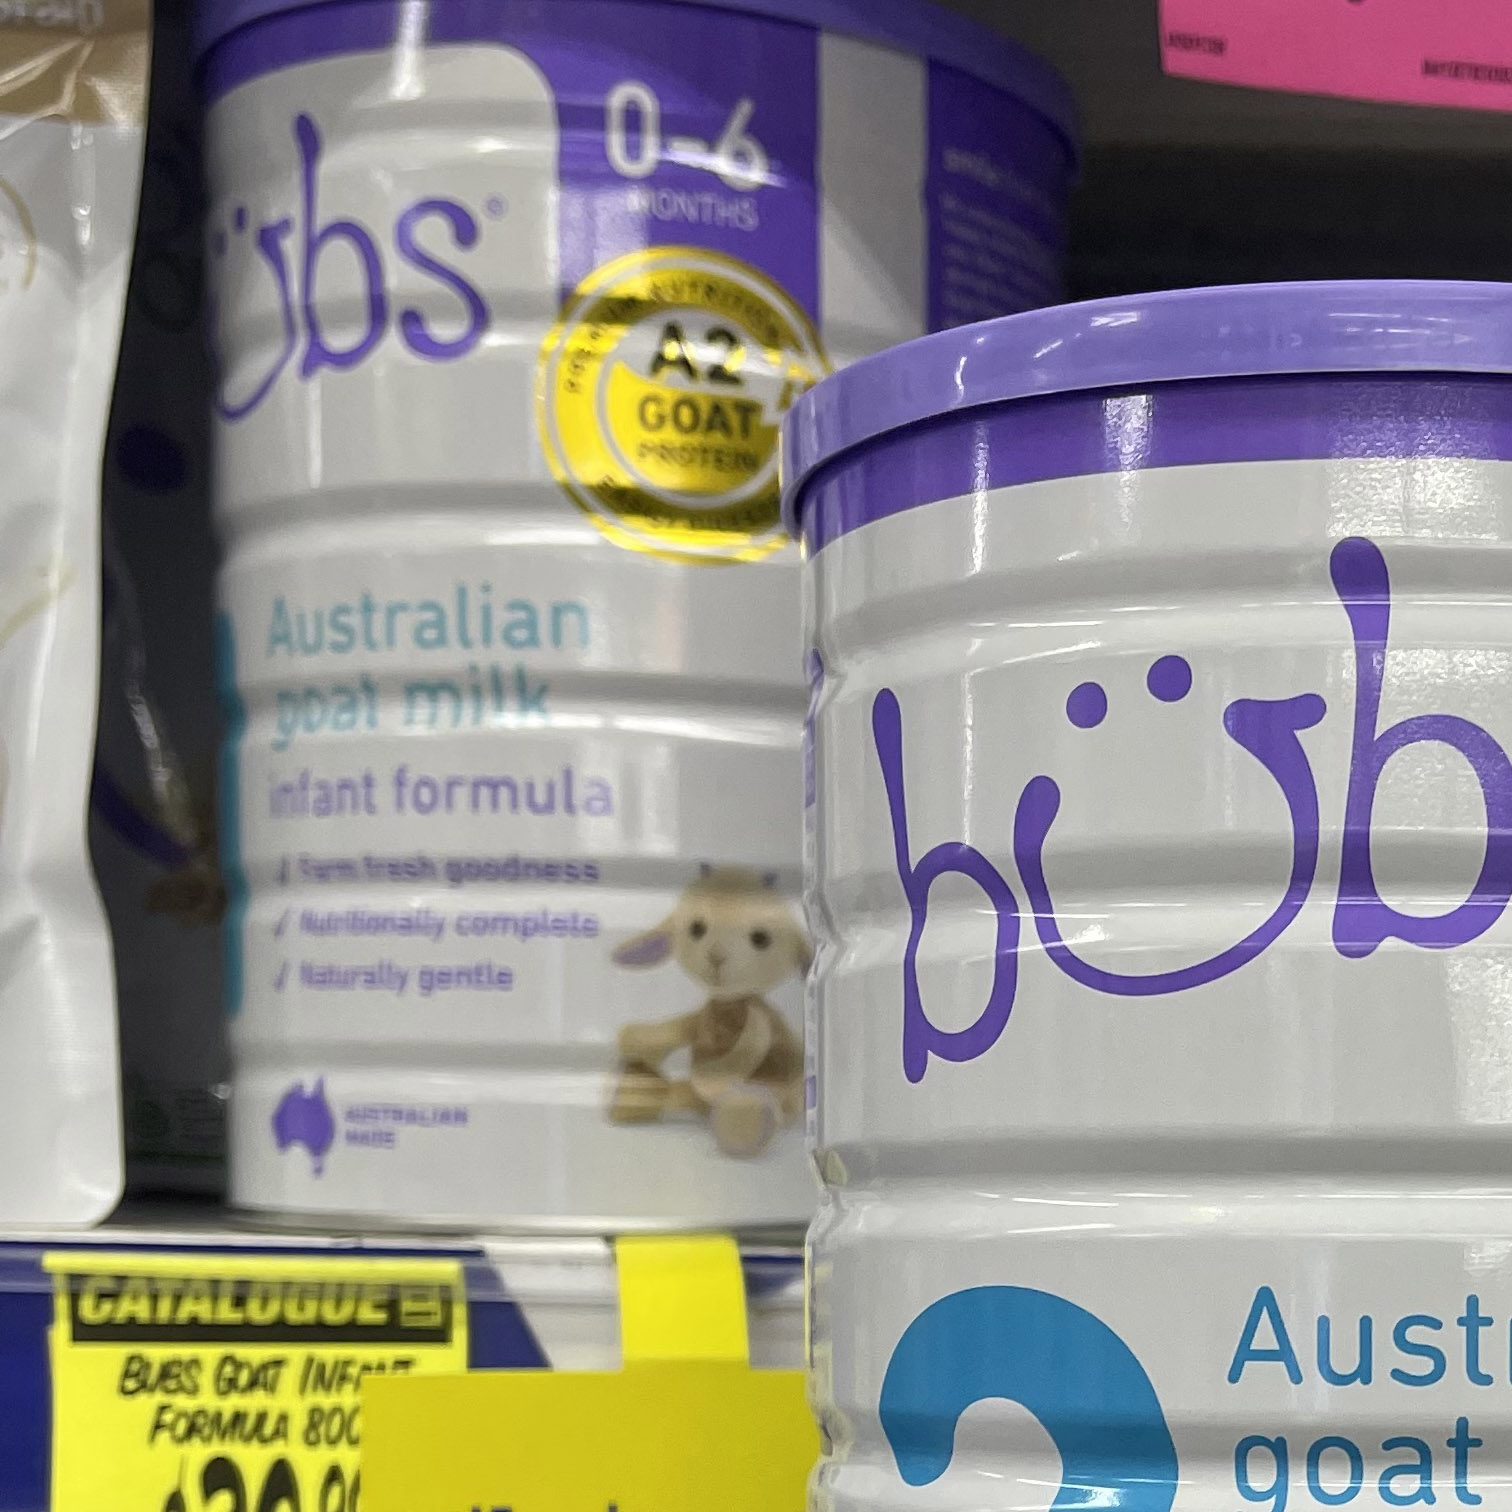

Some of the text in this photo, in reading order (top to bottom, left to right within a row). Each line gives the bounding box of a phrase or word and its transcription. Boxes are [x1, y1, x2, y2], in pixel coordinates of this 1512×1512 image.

[606, 80, 772, 190] 0-6
[628, 192, 760, 233] MONTHS
[650, 320, 745, 388] A2
[638, 395, 762, 440] GOAT
[267, 584, 592, 657] Australian
[273, 664, 550, 752] goat milk
[269, 766, 614, 819] infant formula
[444, 853, 601, 889] goodness
[454, 909, 600, 942] complete
[418, 960, 514, 997] gentle
[76, 1276, 390, 1326] CATALOGUE
[118, 1352, 417, 1397] BUBS GOAT INF
[149, 1404, 289, 1449] FORMULA
